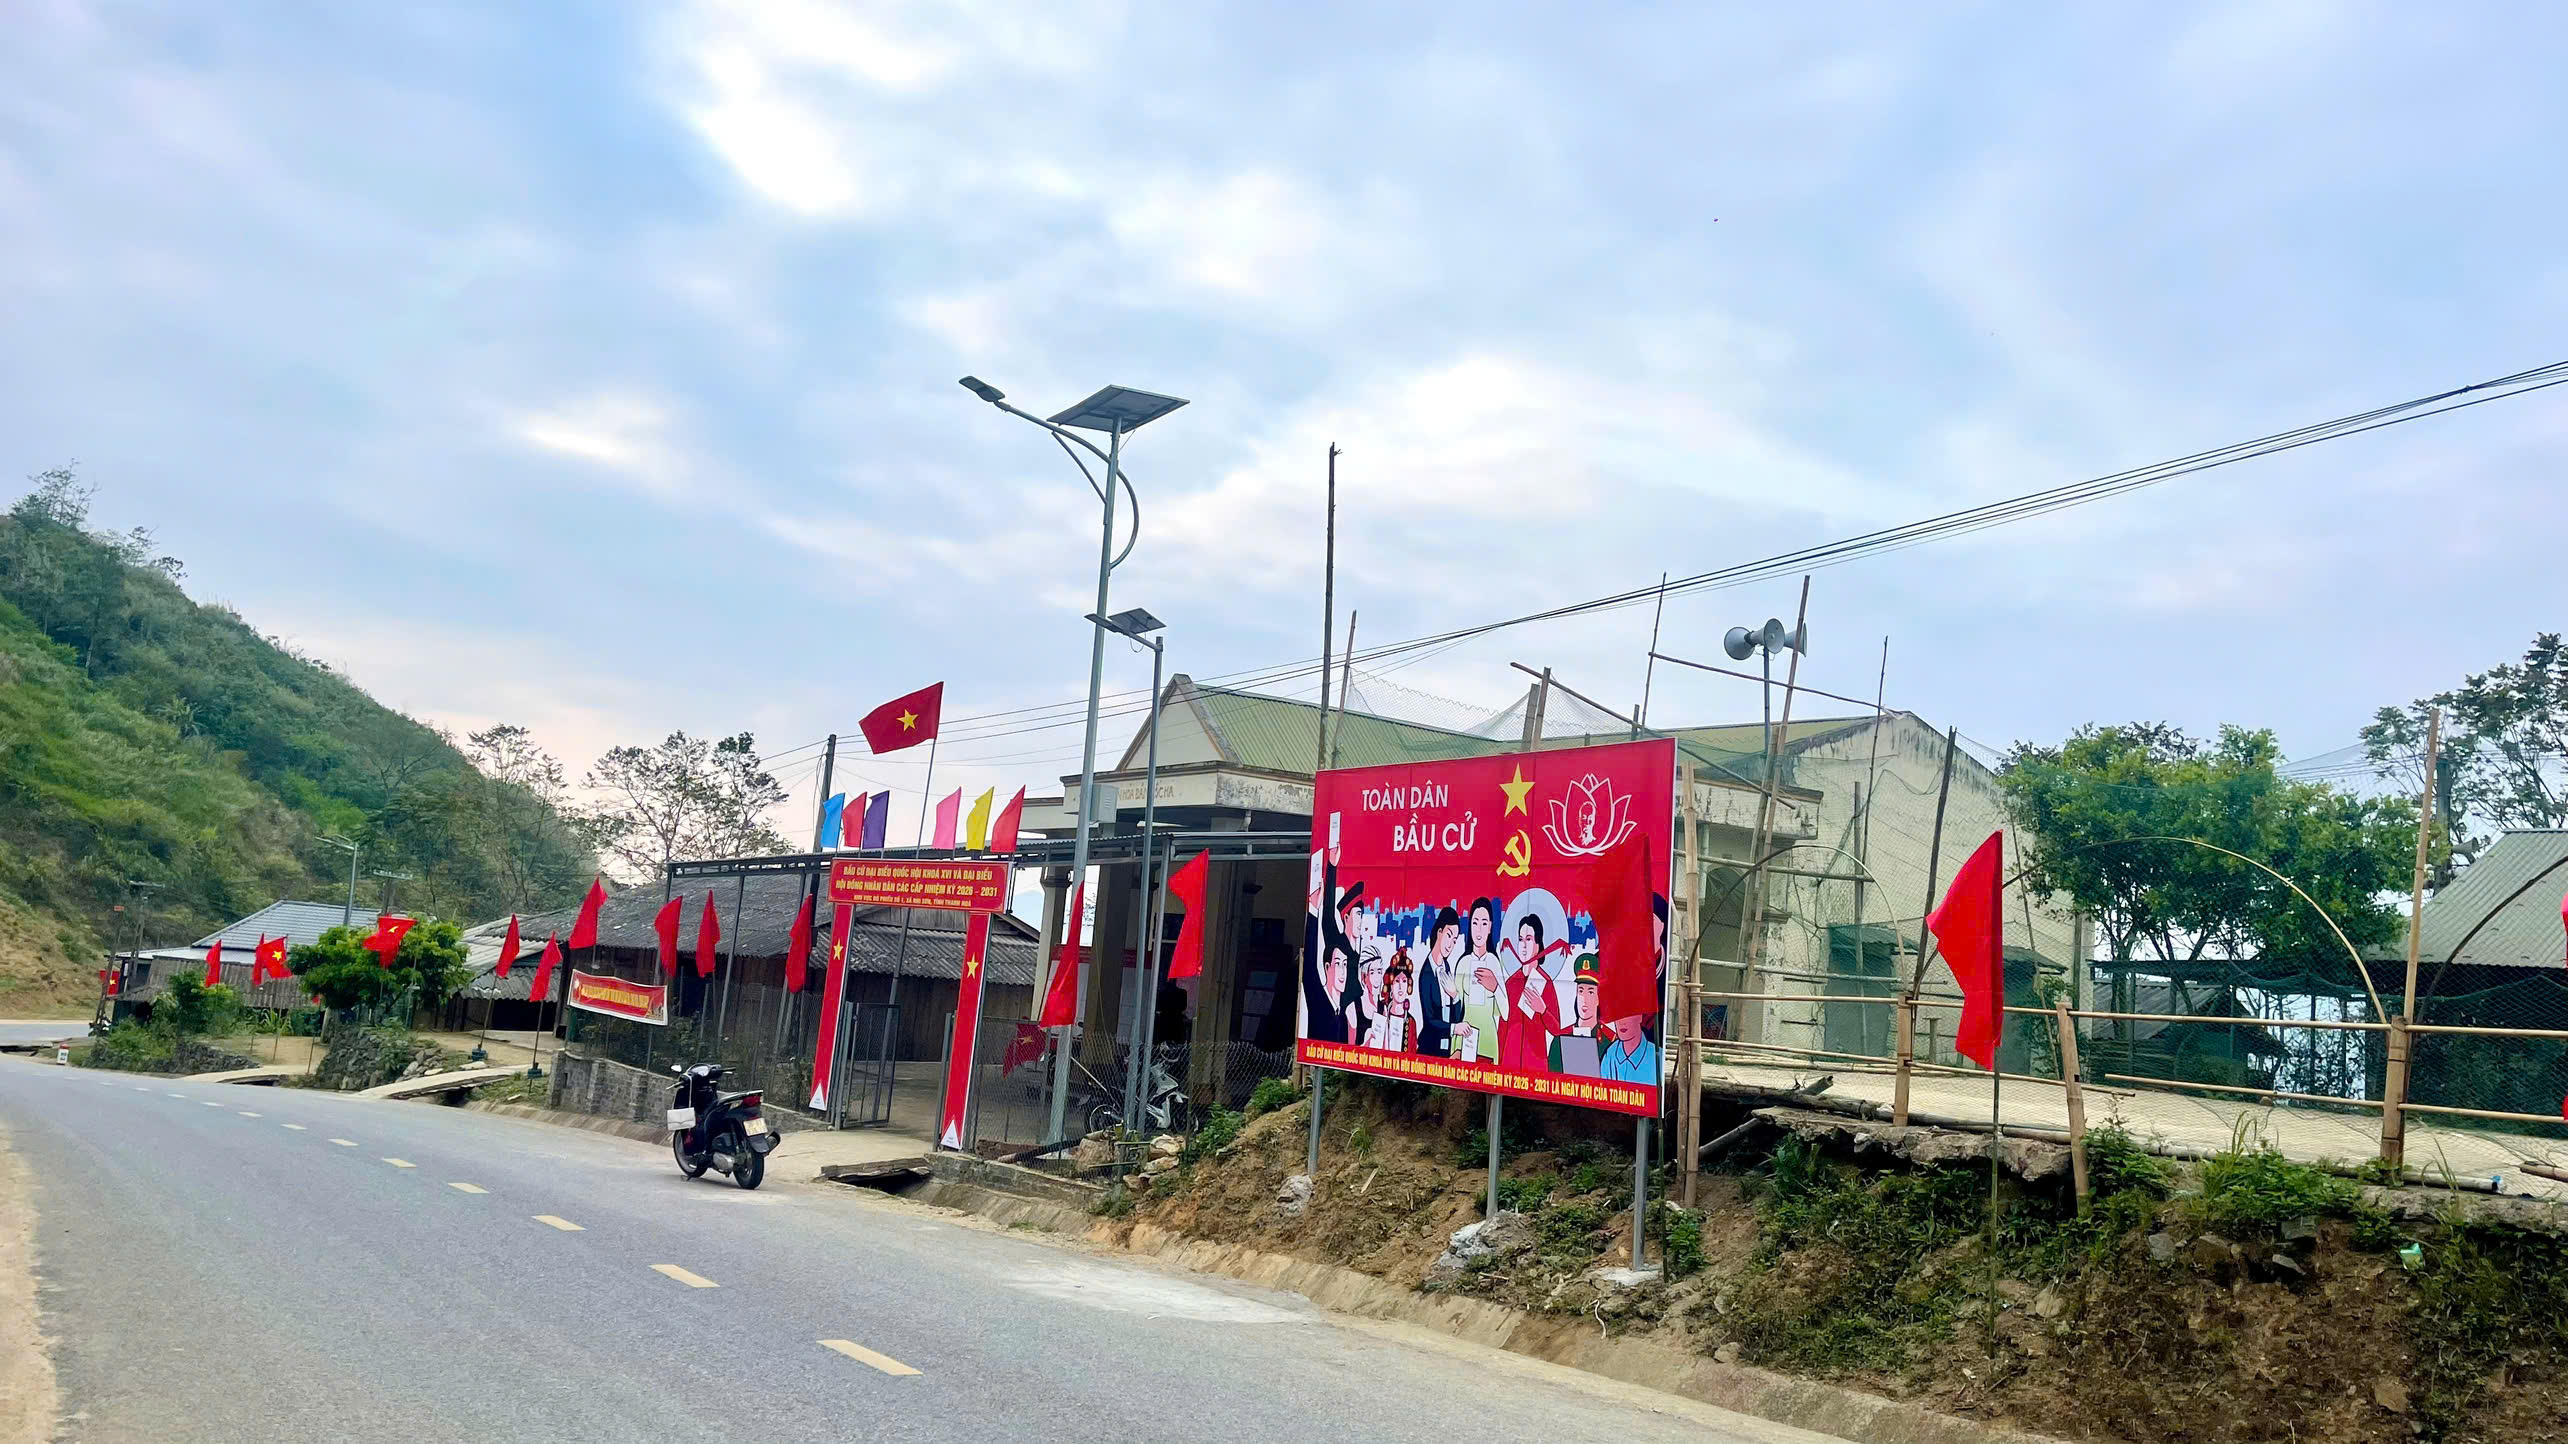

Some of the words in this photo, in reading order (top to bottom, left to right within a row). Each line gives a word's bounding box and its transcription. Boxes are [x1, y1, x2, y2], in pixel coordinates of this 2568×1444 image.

[1362, 782, 1405, 811] TOÀN
[1410, 779, 1448, 809] DÂN
[1393, 812, 1436, 851] BẦU
[1442, 811, 1477, 851] CỬ
[836, 879, 846, 890] HỘI
[847, 879, 863, 890] ĐỒNG
[864, 880, 881, 891] NHÂN
[882, 881, 895, 891] DÂN
[896, 881, 909, 892] CÁC
[910, 881, 923, 893] CẤP
[924, 882, 945, 896] NHIỆM
[946, 883, 956, 894] KỲ
[956, 885, 973, 896] 2026
[981, 887, 998, 896] 2031
[843, 864, 856, 876] BẦU
[856, 864, 865, 876] CỬ
[866, 867, 876, 878] ĐẠI
[877, 865, 891, 877] BIỂU
[892, 866, 909, 878] QUỐC
[910, 867, 921, 879] HỘI
[941, 869, 952, 879] XVI
[953, 868, 962, 880] VÀ
[963, 870, 975, 882] ĐẠI
[976, 867, 992, 880] BIỂU
[1306, 1043, 1316, 1057] BẦU
[1317, 1044, 1324, 1058] CỬ
[1324, 1048, 1333, 1062] ĐẠI
[1333, 1046, 1344, 1062] BIỂU
[1345, 1049, 1358, 1064] QUỐC
[1359, 1052, 1368, 1068] HỘI
[1383, 1057, 1392, 1069] XVI
[1393, 1056, 1400, 1070] VÀ
[1401, 1058, 1410, 1074] HỘI
[1411, 1058, 1426, 1074] ĐỒNG
[1427, 1062, 1442, 1077] NHÂN
[1443, 1064, 1455, 1080] DÂN
[1456, 1066, 1468, 1082] CÁC
[1470, 1066, 1482, 1082] CẤP
[1483, 1070, 1502, 1088] NHIỆM
[1504, 1072, 1512, 1088] KỲ
[1514, 1076, 1528, 1090] 2026
[1534, 1079, 1550, 1093] 2031
[1552, 1079, 1560, 1094] LÀ
[1561, 1080, 1579, 1097] NGÀY
[1580, 1082, 1592, 1102] HỘI
[1594, 1083, 1608, 1101] CỦA
[1609, 1087, 1628, 1104] TOÀN
[1629, 1090, 1645, 1107] DÂN
